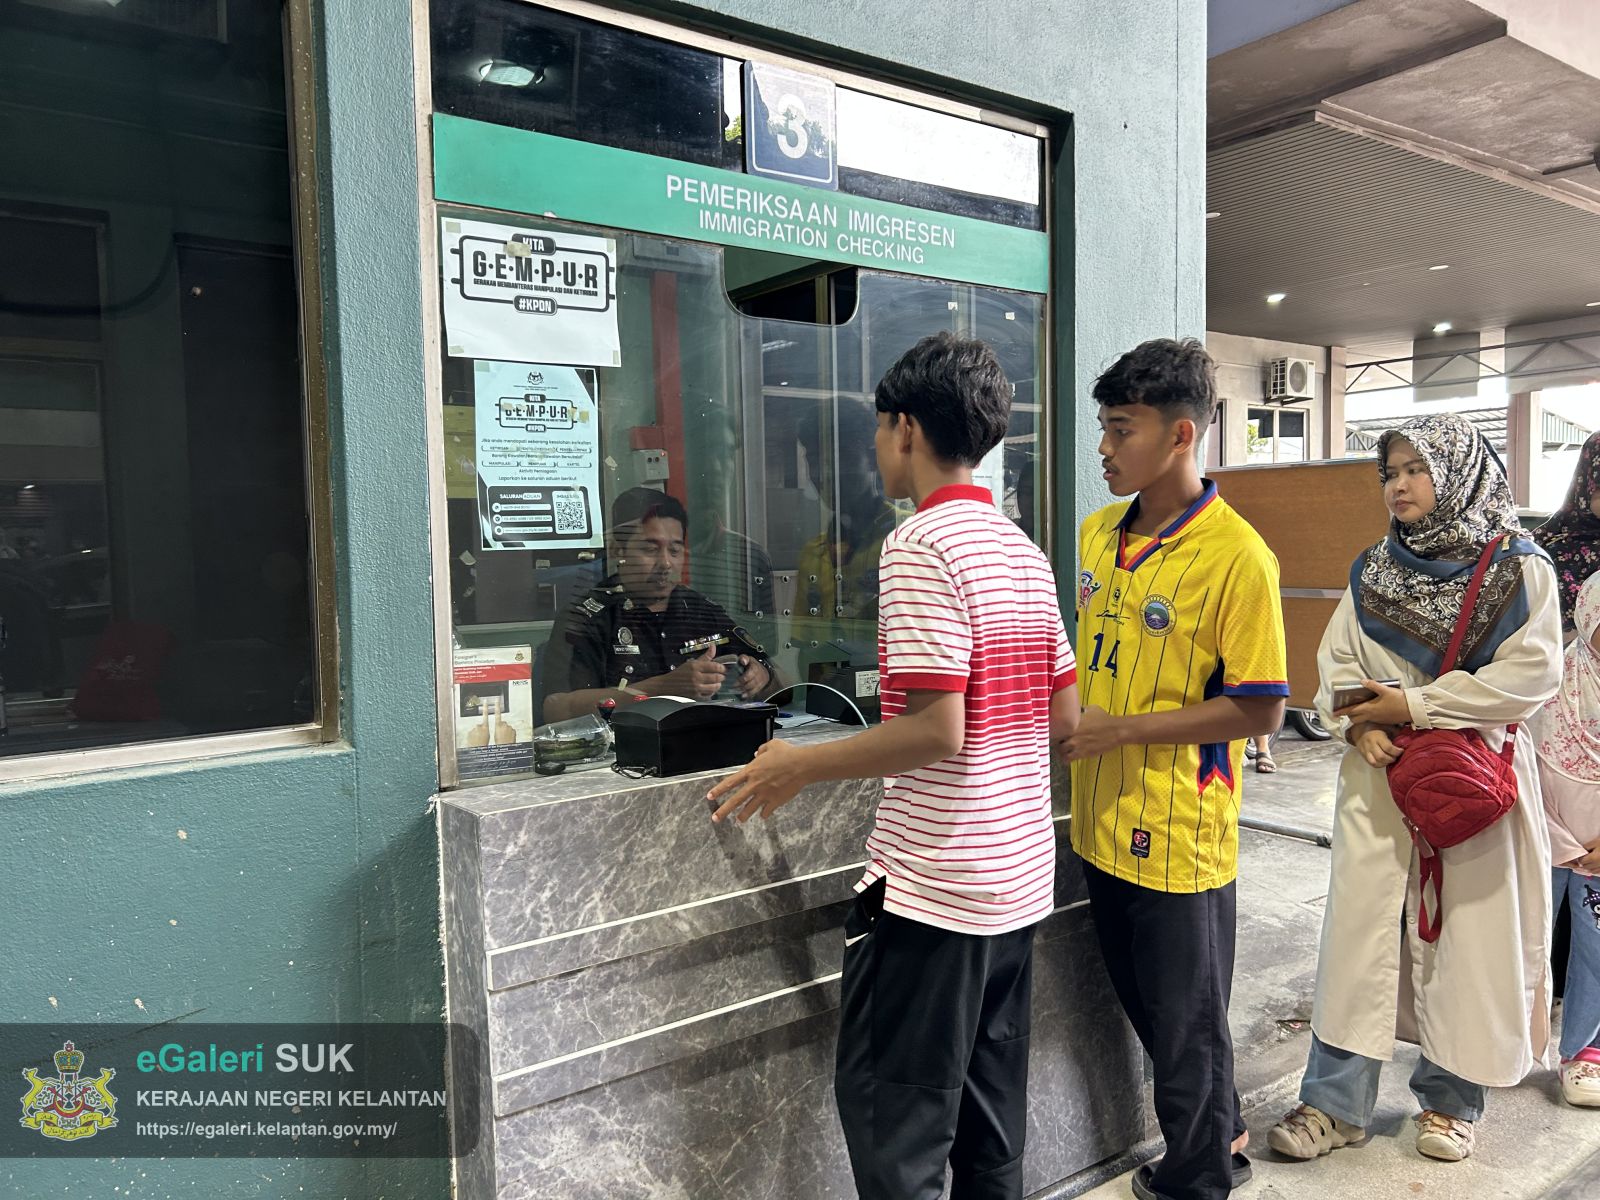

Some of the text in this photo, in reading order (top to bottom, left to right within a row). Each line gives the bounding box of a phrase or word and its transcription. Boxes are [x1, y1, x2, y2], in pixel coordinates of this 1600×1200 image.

[777, 93, 808, 159] 3
[666, 174, 955, 249] PEMERIKSAAN IMIGRESEN
[699, 209, 924, 264] IMMIGRATION CHECKING
[518, 298, 552, 313] #KPDN
[1088, 632, 1121, 679] 14
